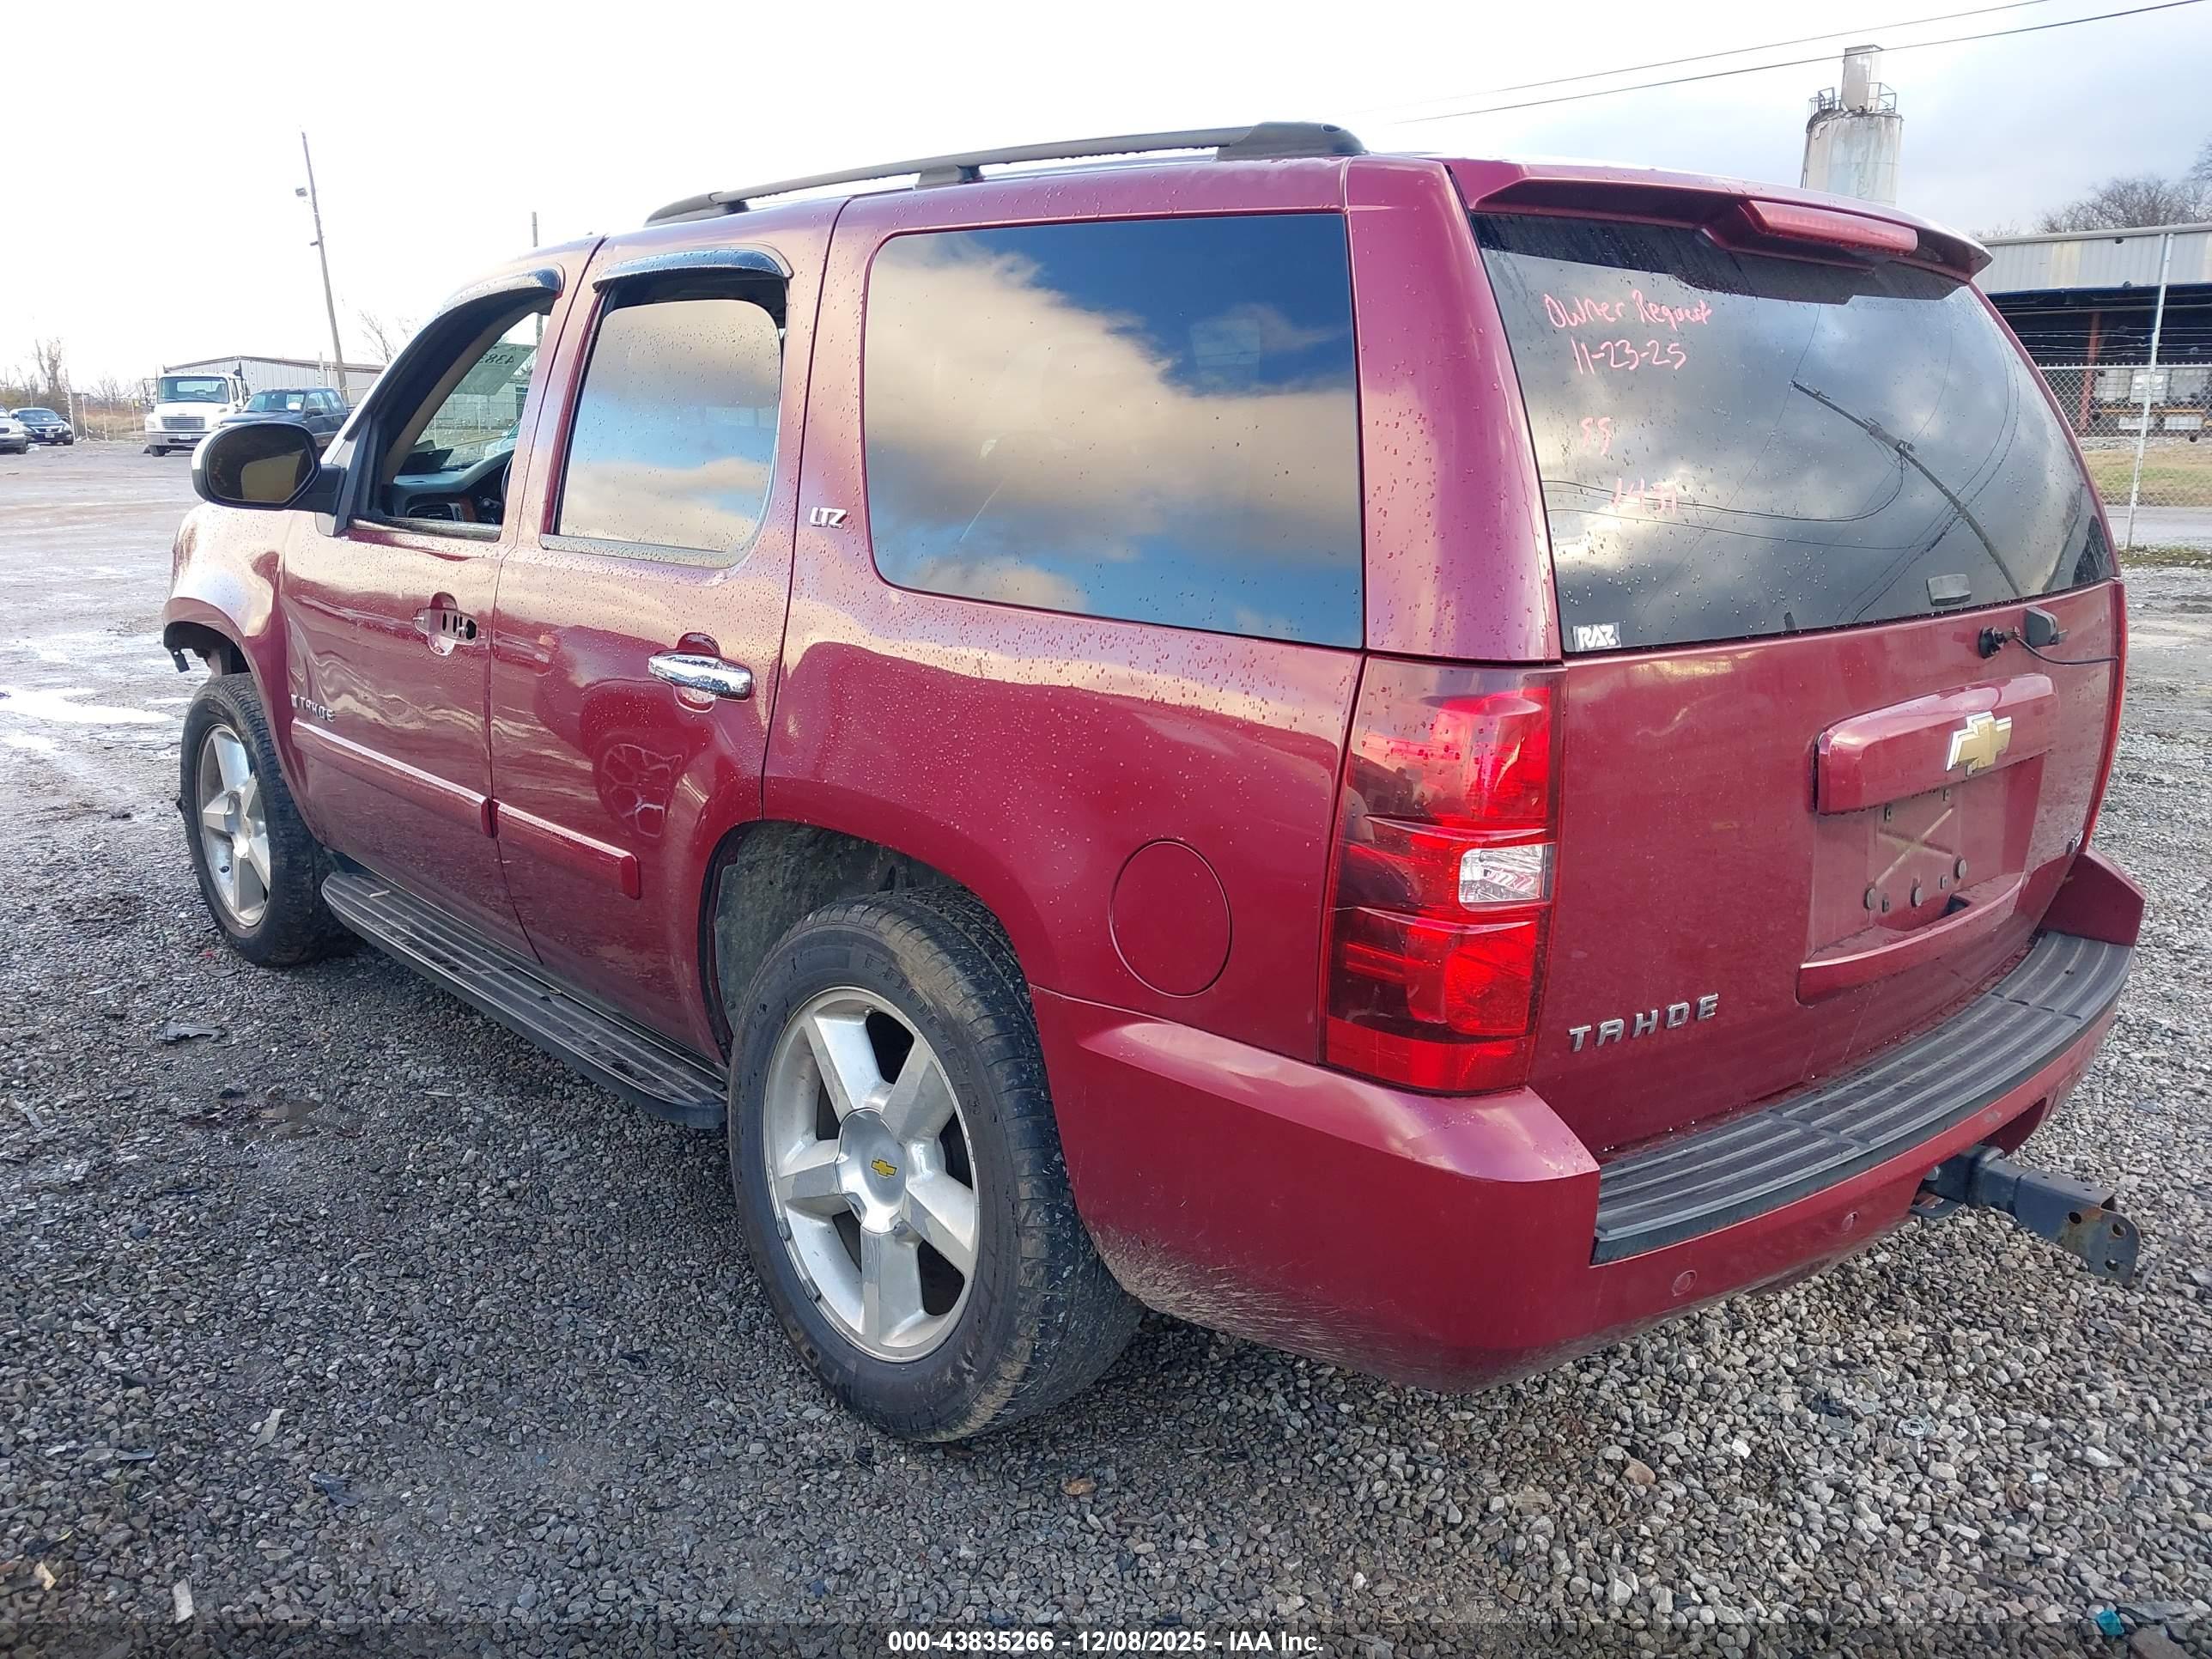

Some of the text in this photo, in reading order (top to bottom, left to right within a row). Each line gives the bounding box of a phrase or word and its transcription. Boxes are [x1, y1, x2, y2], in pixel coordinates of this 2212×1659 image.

[1570, 337, 1687, 374] 11-23-25
[810, 507, 848, 528] LTZ
[298, 696, 337, 722] TAHOE
[1568, 993, 1720, 1053] TAHOE
